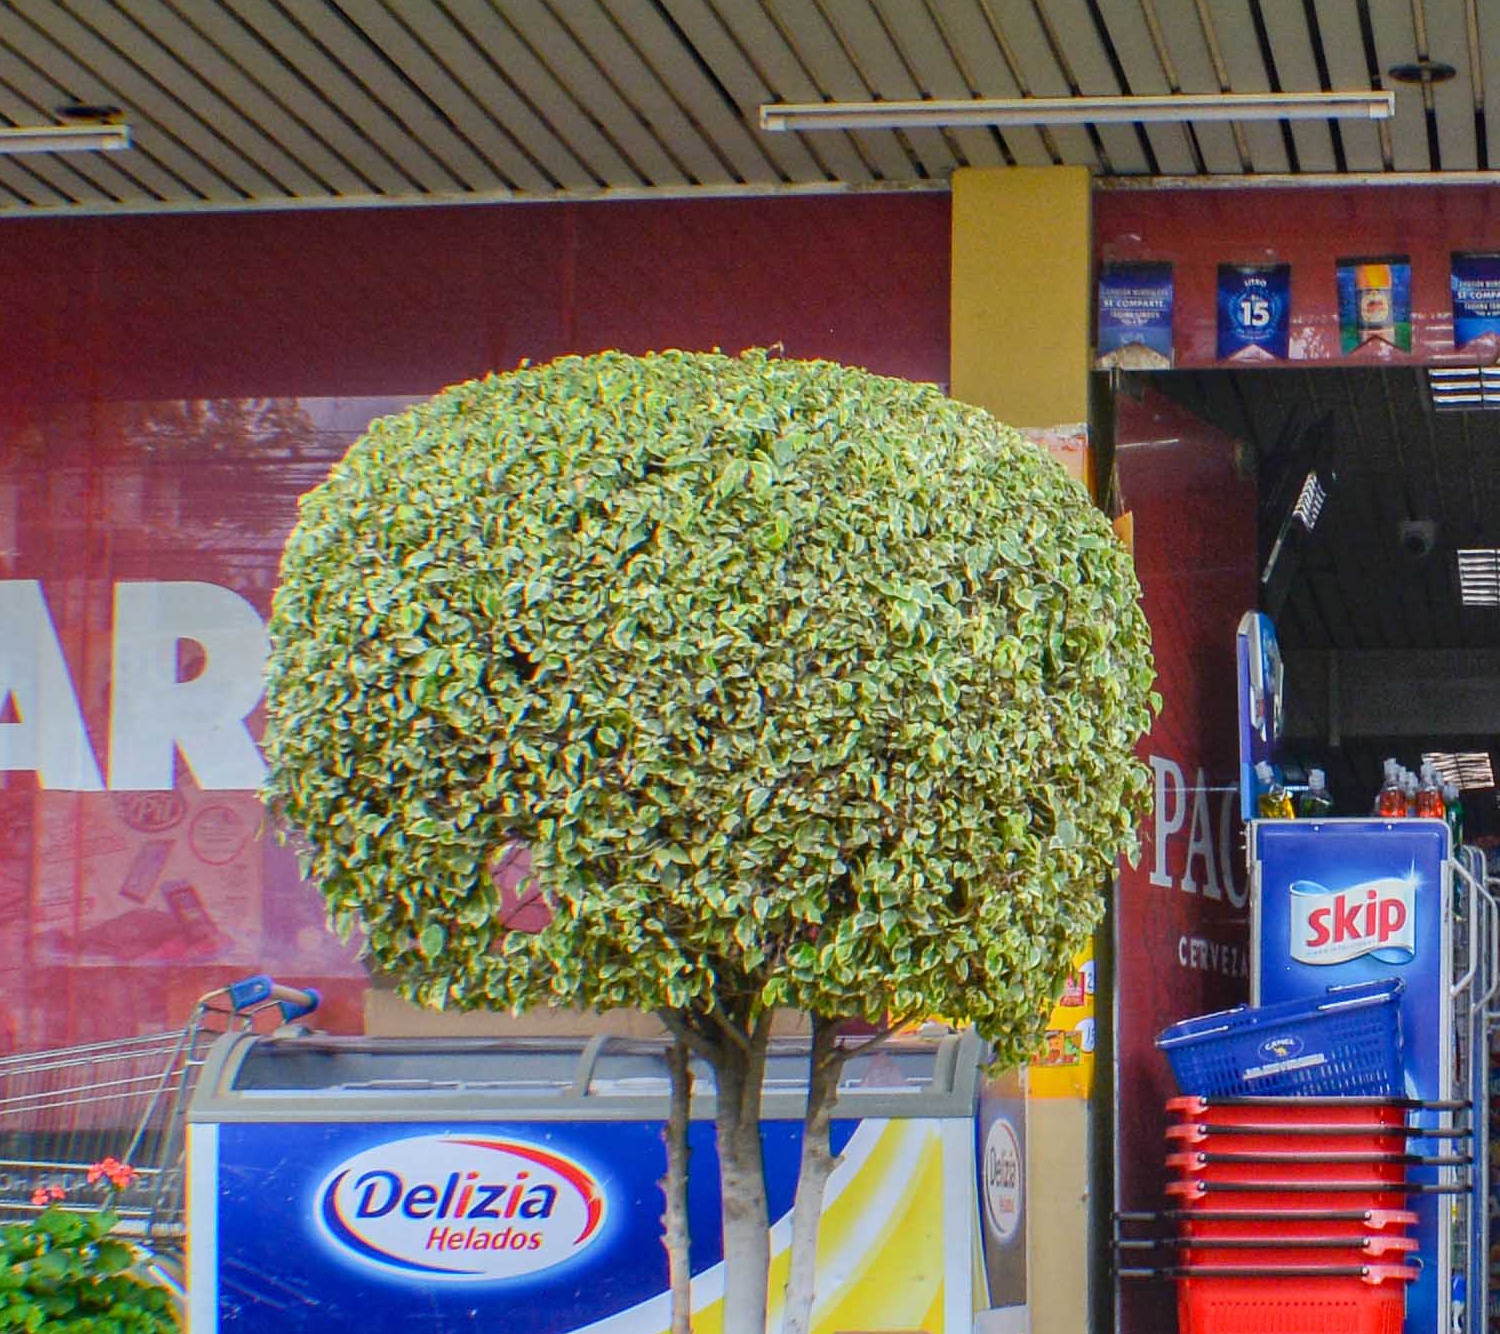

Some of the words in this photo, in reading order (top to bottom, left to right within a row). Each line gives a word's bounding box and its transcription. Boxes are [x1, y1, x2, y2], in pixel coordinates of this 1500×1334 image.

[1240, 300, 1270, 327] 15
[1305, 890, 1407, 948] skip
[1179, 935, 1250, 980] CERVEZA
[355, 1169, 558, 1219] Delizia
[426, 1226, 543, 1251] Helados
